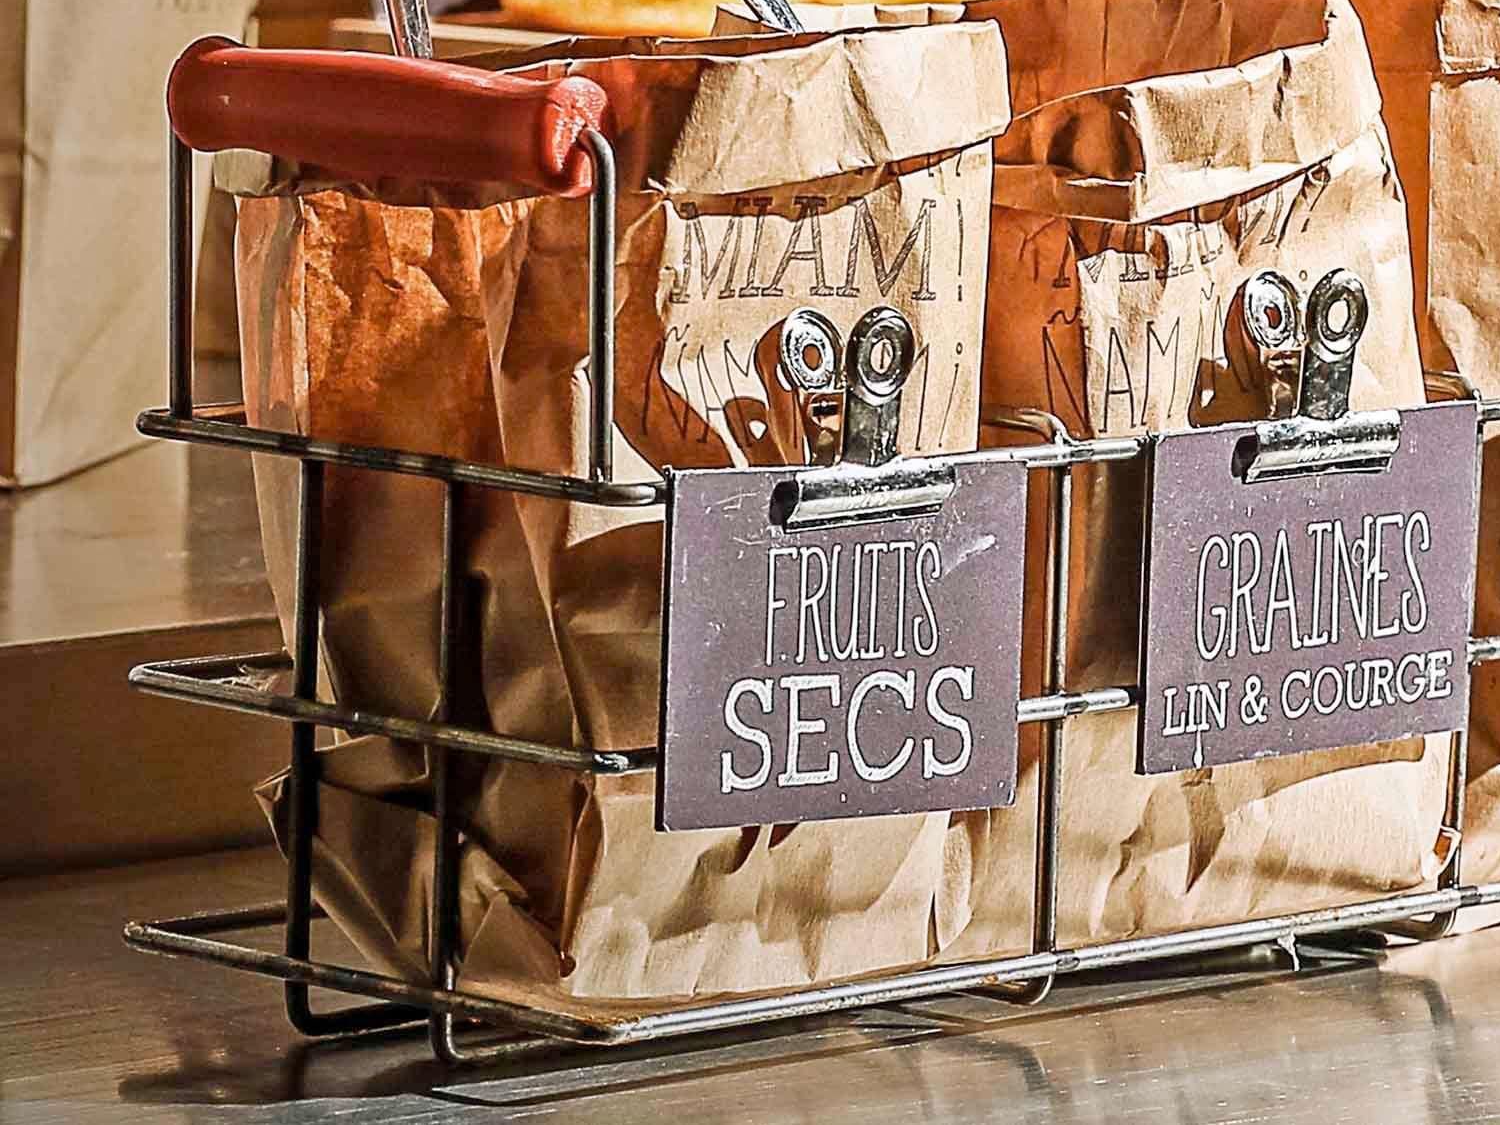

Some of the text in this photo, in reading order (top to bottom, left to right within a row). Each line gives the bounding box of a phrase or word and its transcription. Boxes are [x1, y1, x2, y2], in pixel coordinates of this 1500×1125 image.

[765, 540, 942, 665] FRUITS
[1195, 511, 1431, 661] GRAINES
[719, 665, 975, 794] SECS
[1162, 650, 1453, 737] LIN & COURGE
